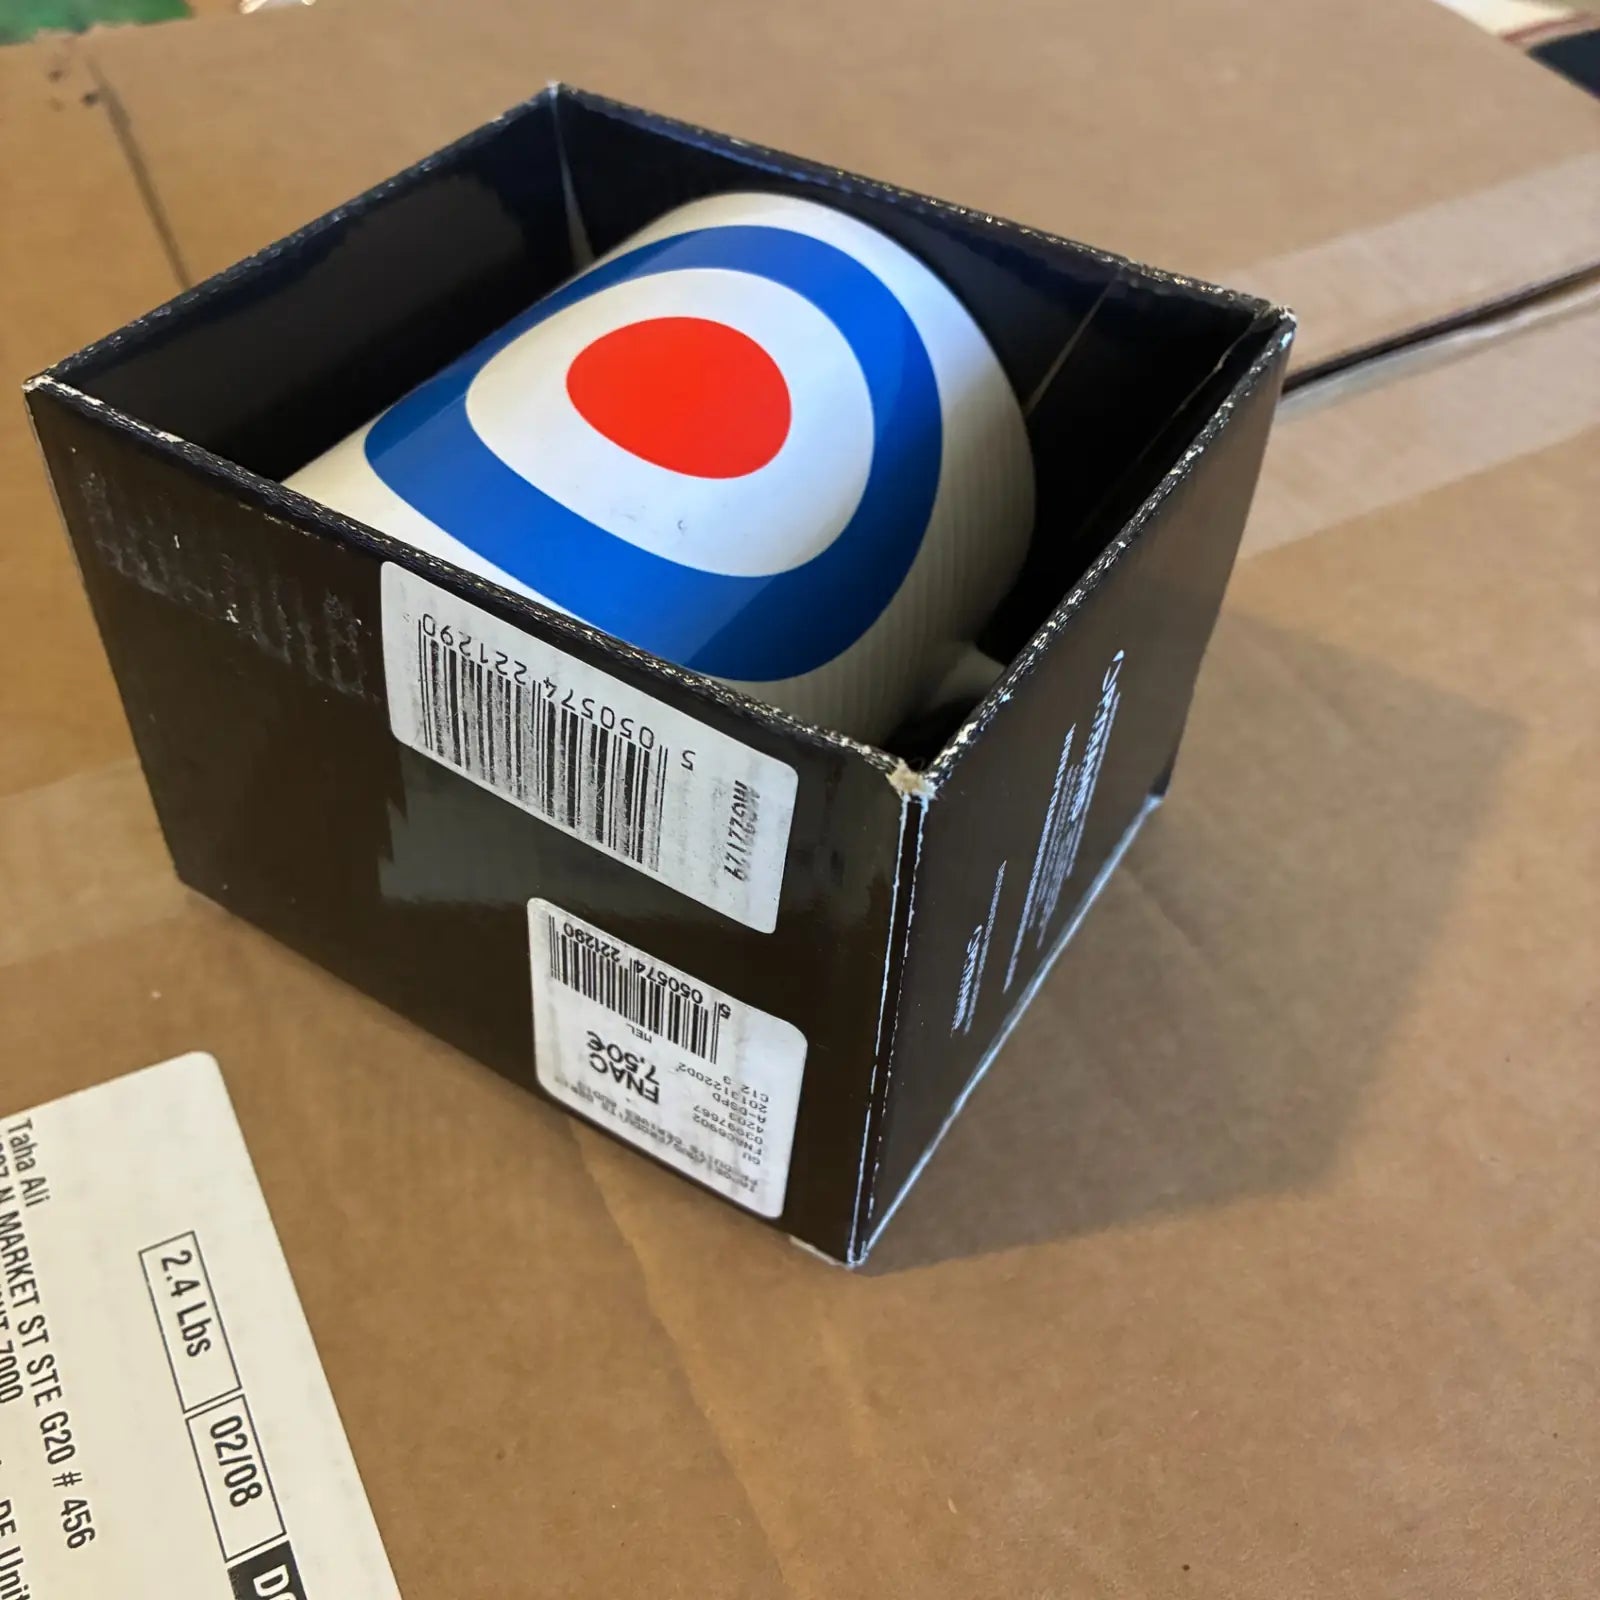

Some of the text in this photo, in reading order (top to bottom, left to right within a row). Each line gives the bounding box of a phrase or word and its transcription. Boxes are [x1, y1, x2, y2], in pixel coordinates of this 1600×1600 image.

[423, 613, 697, 771] 5 050574 221290
[563, 922, 732, 1020] 5 050574 221290
[586, 1030, 661, 1084] 7,50€
[626, 1024, 652, 1043] MEL
[588, 1054, 660, 1105] FNAC
[8, 1117, 50, 1207] Taha Ali
[0, 1210, 41, 1309] MARKET
[160, 1249, 213, 1357] 2.4 Lbs
[17, 1314, 50, 1348] ST
[26, 1353, 63, 1408] STE
[39, 1410, 76, 1465] G20
[209, 1414, 263, 1508] 02/08
[51, 1471, 83, 1488] #
[60, 1498, 96, 1549] 456
